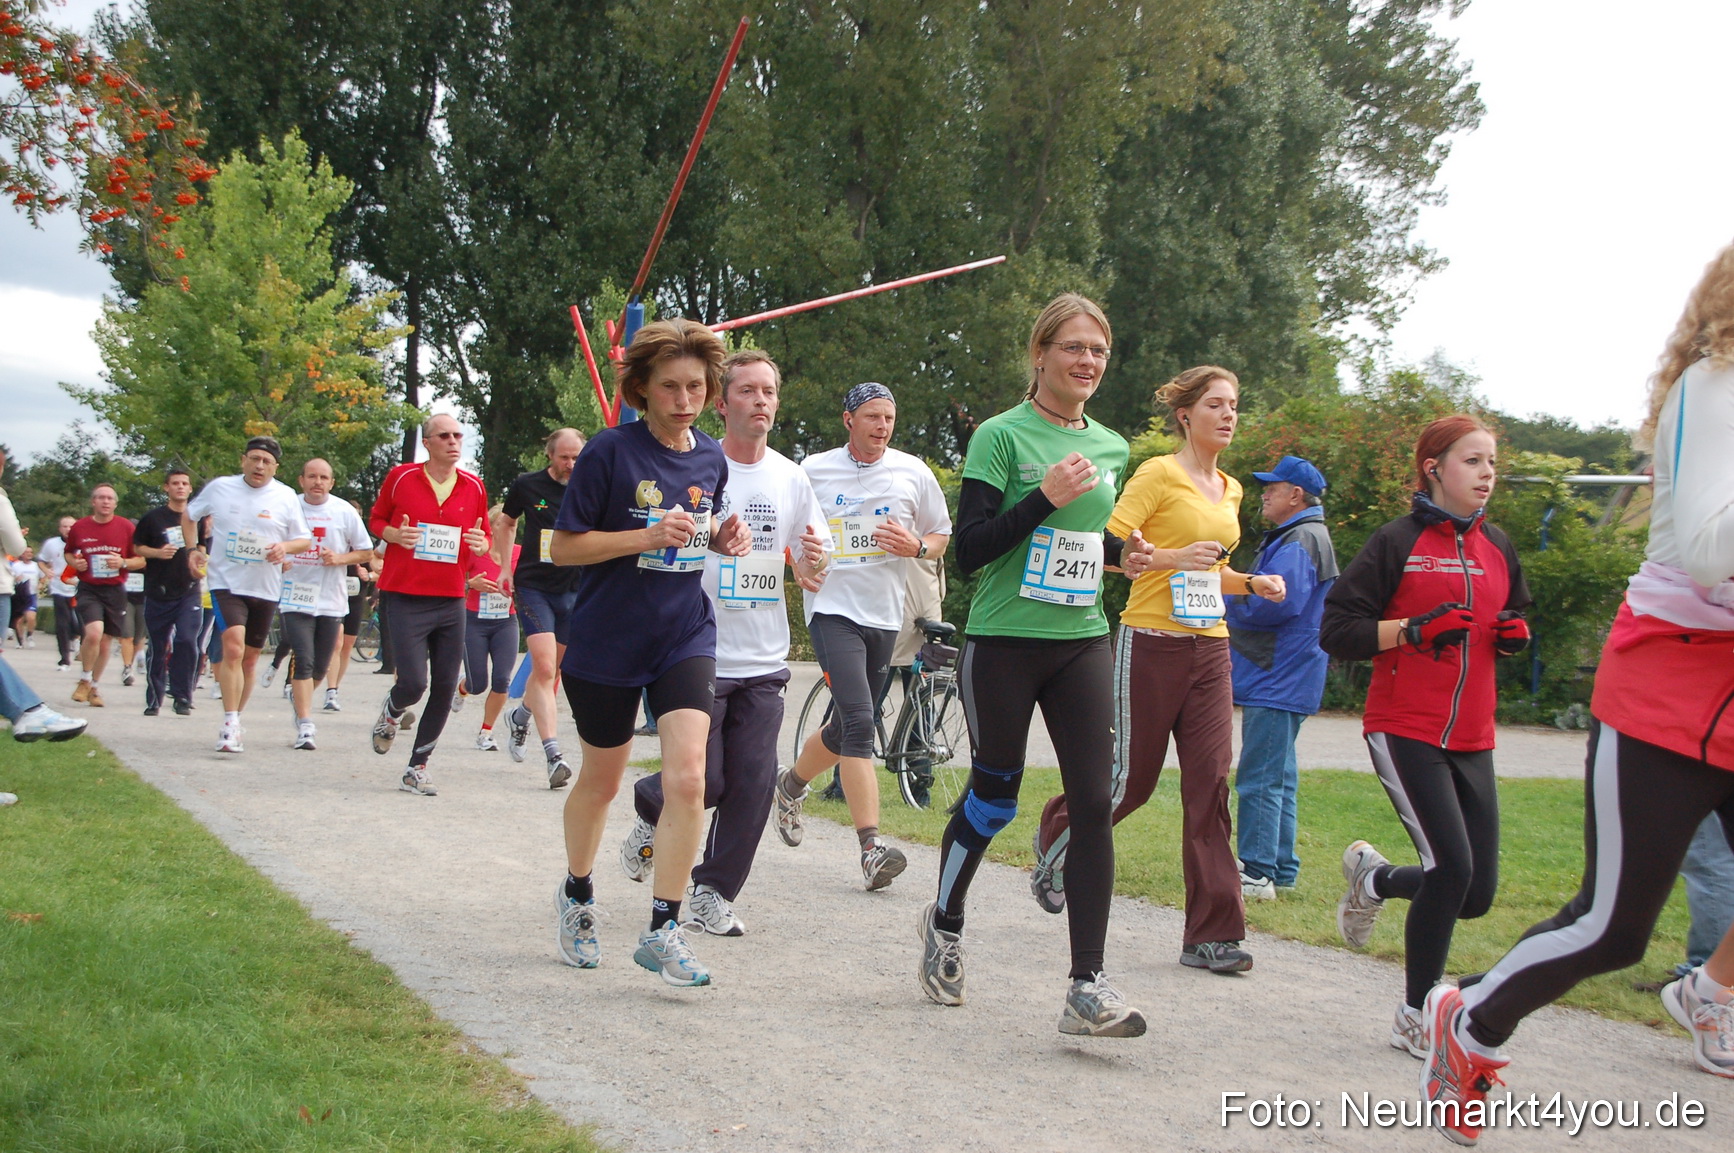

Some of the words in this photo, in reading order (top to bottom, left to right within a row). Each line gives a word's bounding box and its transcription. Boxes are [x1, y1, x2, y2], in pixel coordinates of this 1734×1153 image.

[742, 514, 777, 523] 21.09.2008
[844, 521, 861, 531] Tom
[430, 538, 456, 550] 2070
[752, 535, 774, 544] arkter
[851, 534, 878, 549] 885
[1057, 536, 1085, 552] Petra
[237, 545, 262, 555] 3424
[752, 543, 774, 551] dtlauf
[1034, 552, 1041, 563] D
[1053, 558, 1097, 580] 2471
[741, 573, 777, 590] 3700
[292, 592, 316, 604] 2486
[1187, 593, 1218, 608] 2300
[490, 602, 509, 610] 3465
